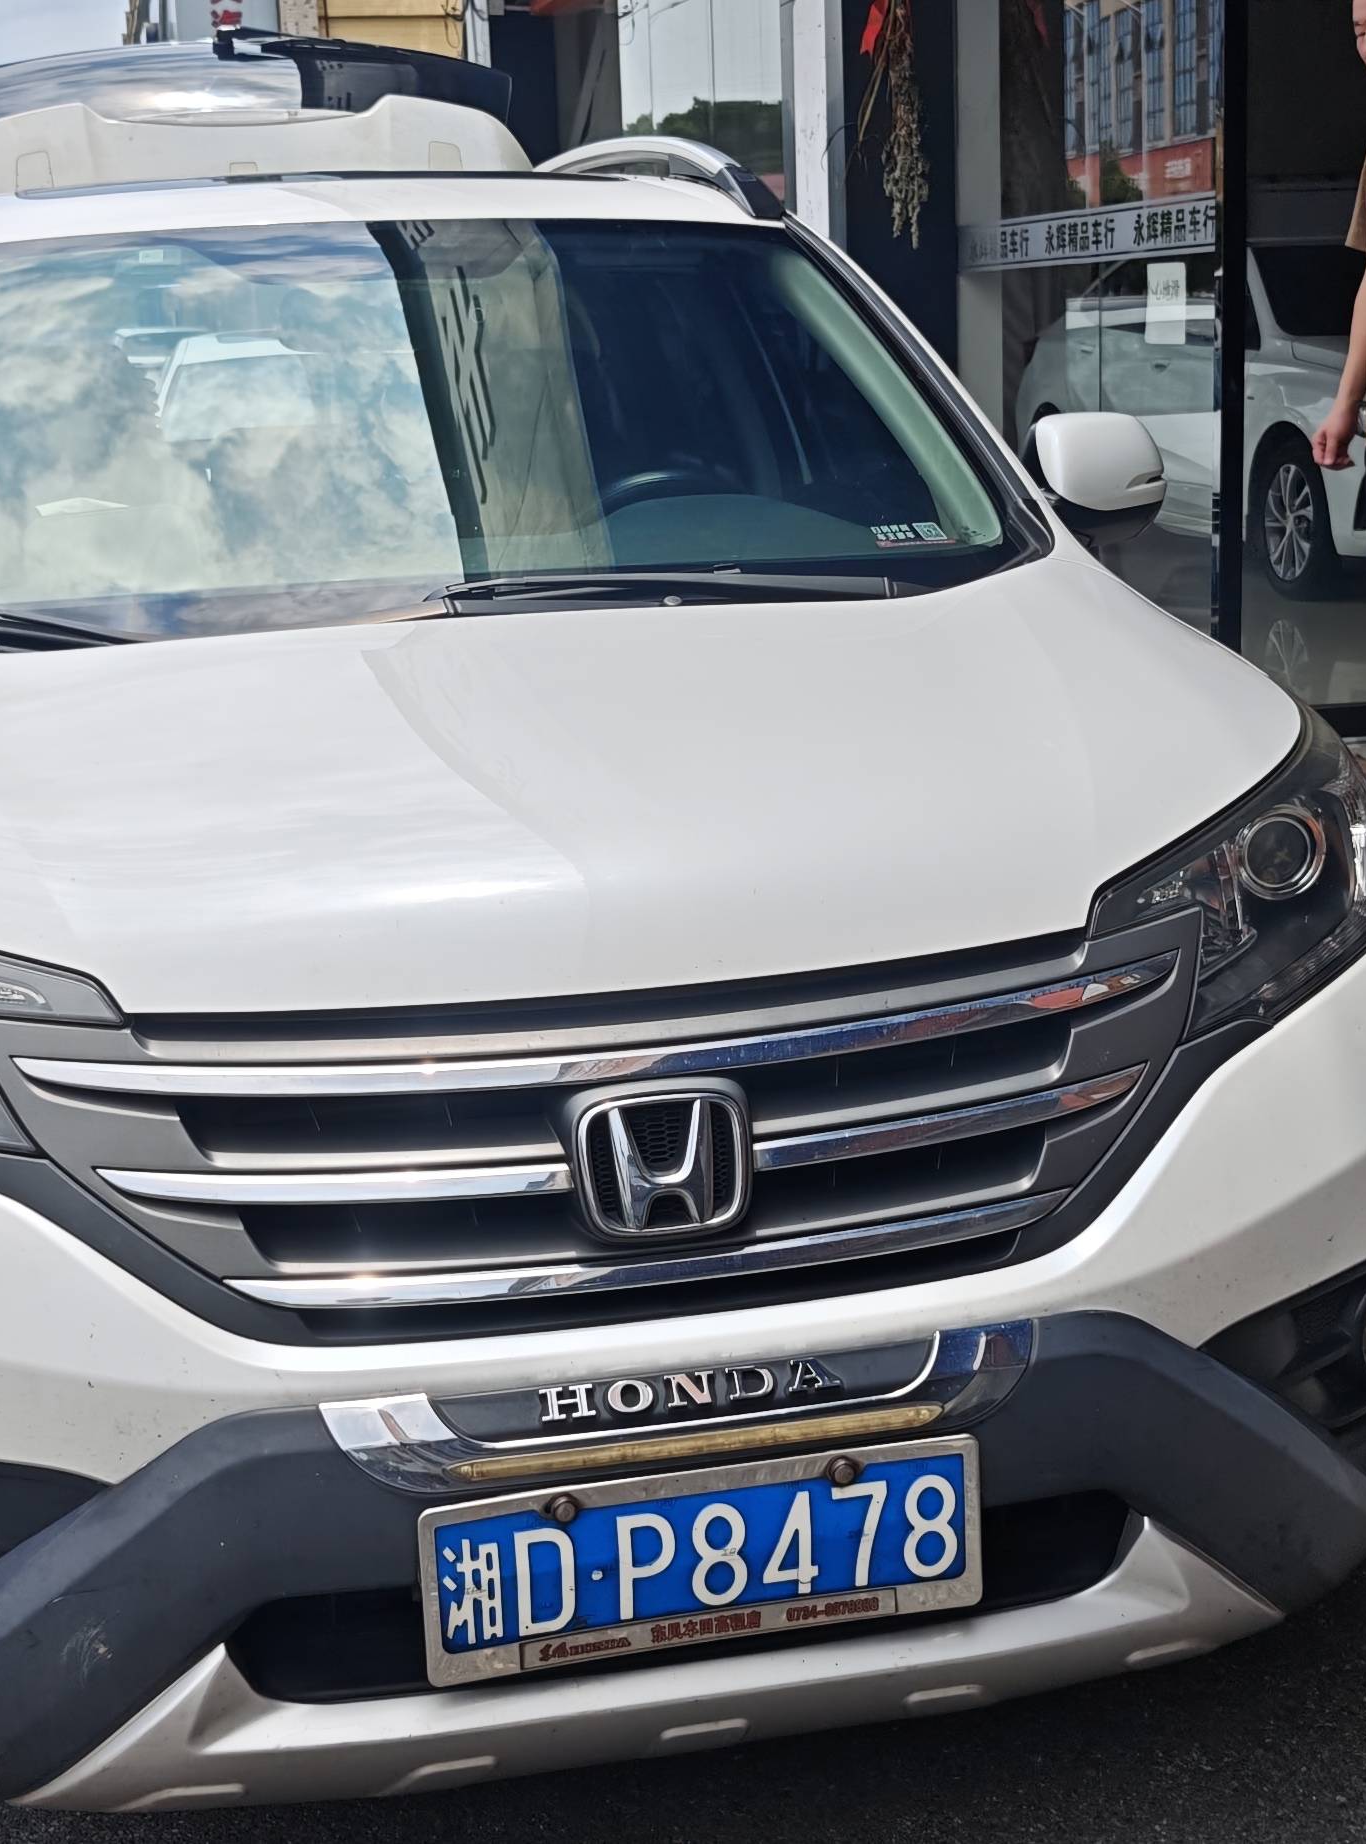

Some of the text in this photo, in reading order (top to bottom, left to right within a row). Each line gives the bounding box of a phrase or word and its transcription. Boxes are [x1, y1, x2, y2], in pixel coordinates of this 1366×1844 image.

[1044, 217, 1115, 256] 永辉精品车行
[1133, 204, 1216, 248] 永辉精品车行
[538, 1357, 842, 1424] HONDA
